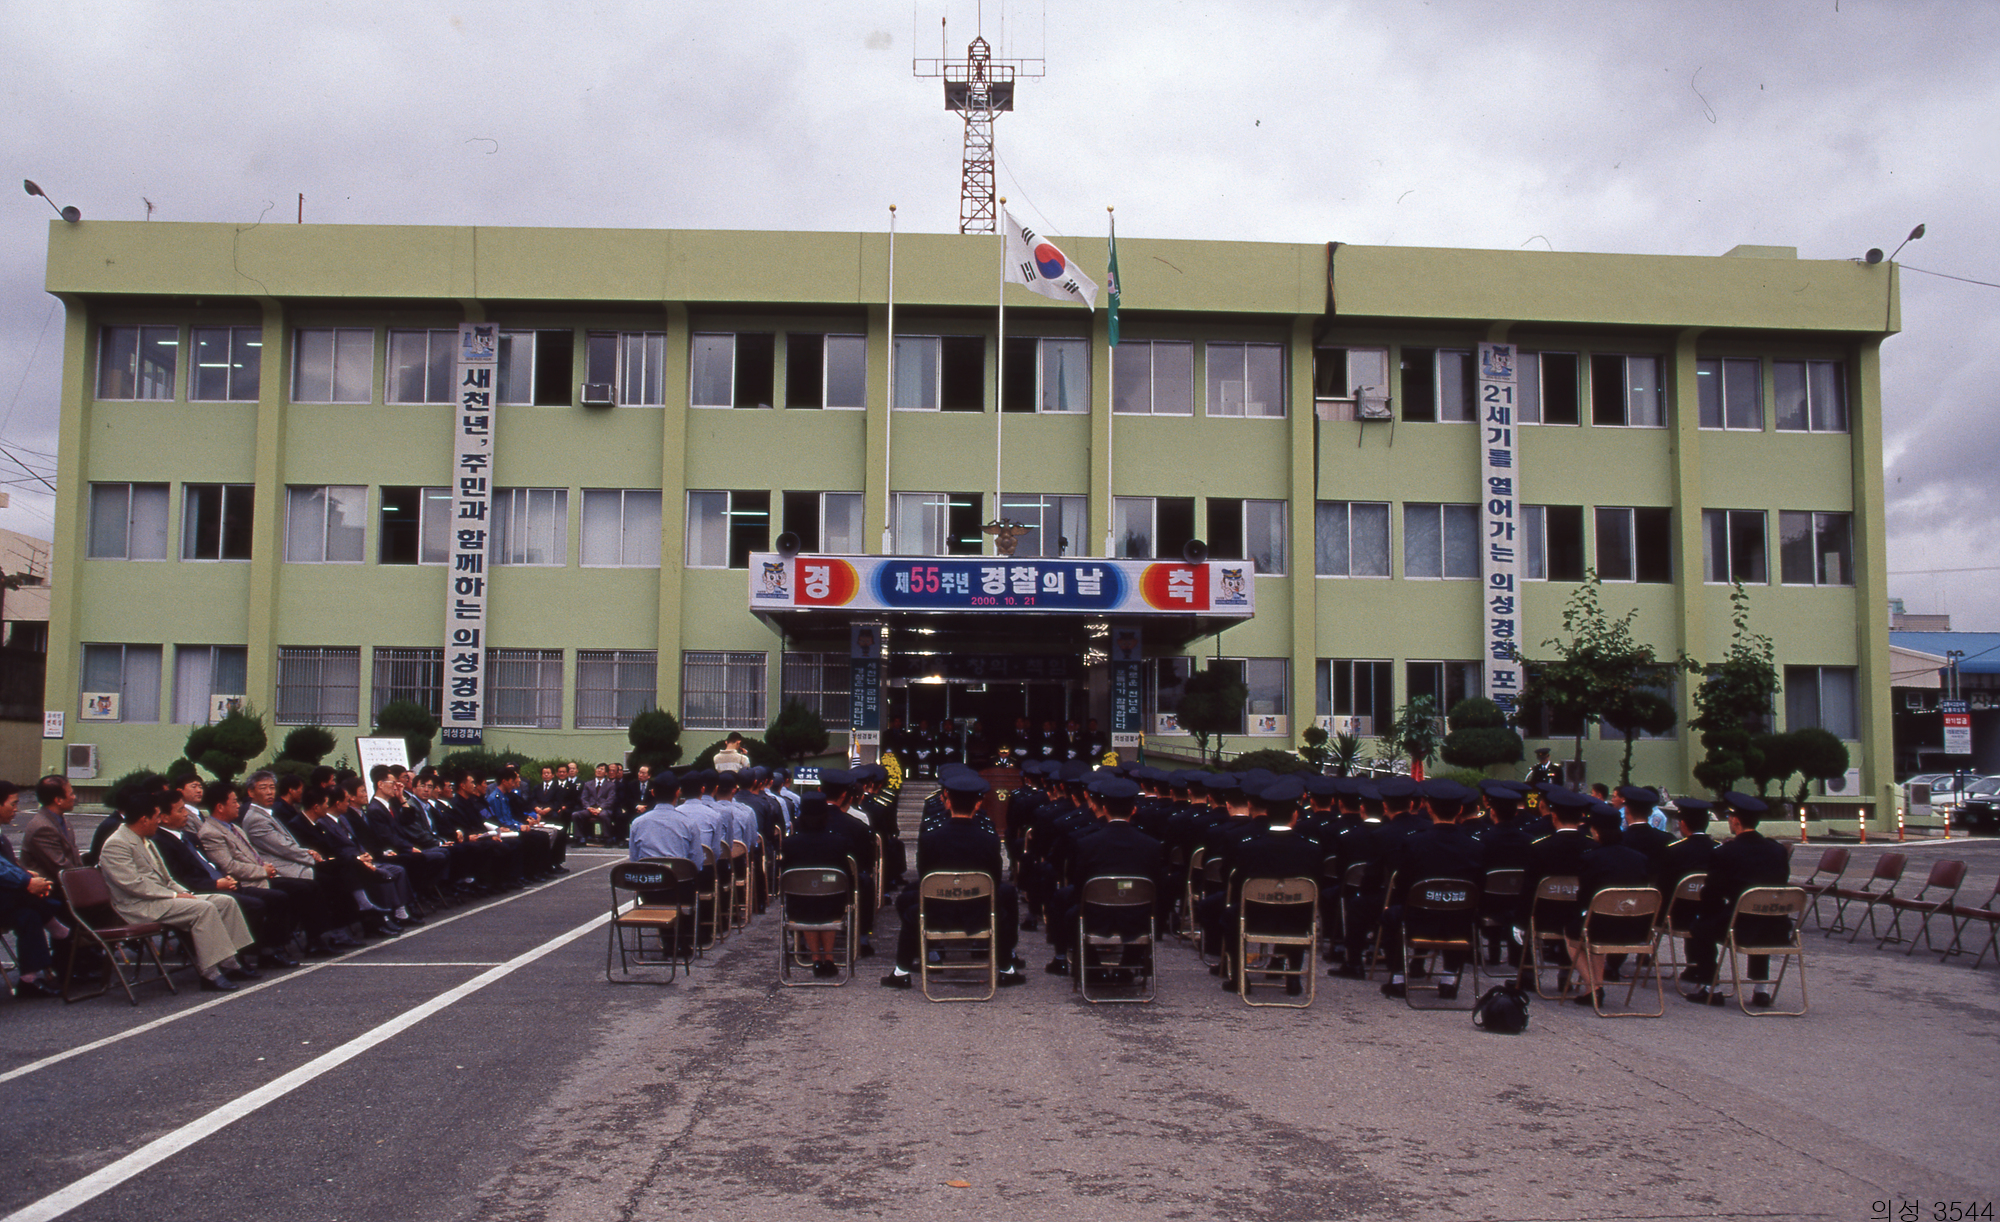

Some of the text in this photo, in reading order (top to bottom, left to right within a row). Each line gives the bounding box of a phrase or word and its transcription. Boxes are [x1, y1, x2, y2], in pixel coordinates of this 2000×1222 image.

[462, 368, 491, 446] 새천년,
[1484, 384, 1513, 468] 21세기를
[458, 454, 488, 520] 주민과
[1488, 476, 1515, 563] 열어가는
[454, 529, 487, 620] 함께하는
[804, 565, 830, 599] 경
[895, 566, 1103, 595] 제55주년 경찰의 날
[971, 597, 1035, 605] 2000. 10. 21
[1168, 569, 1194, 603] 축
[1489, 573, 1518, 660] 의성경찰
[449, 628, 480, 721] 의성경찰
[966, 658, 1008, 675] 창의
[1026, 658, 1067, 676] 책임
[443, 728, 482, 739] 의성경찰서
